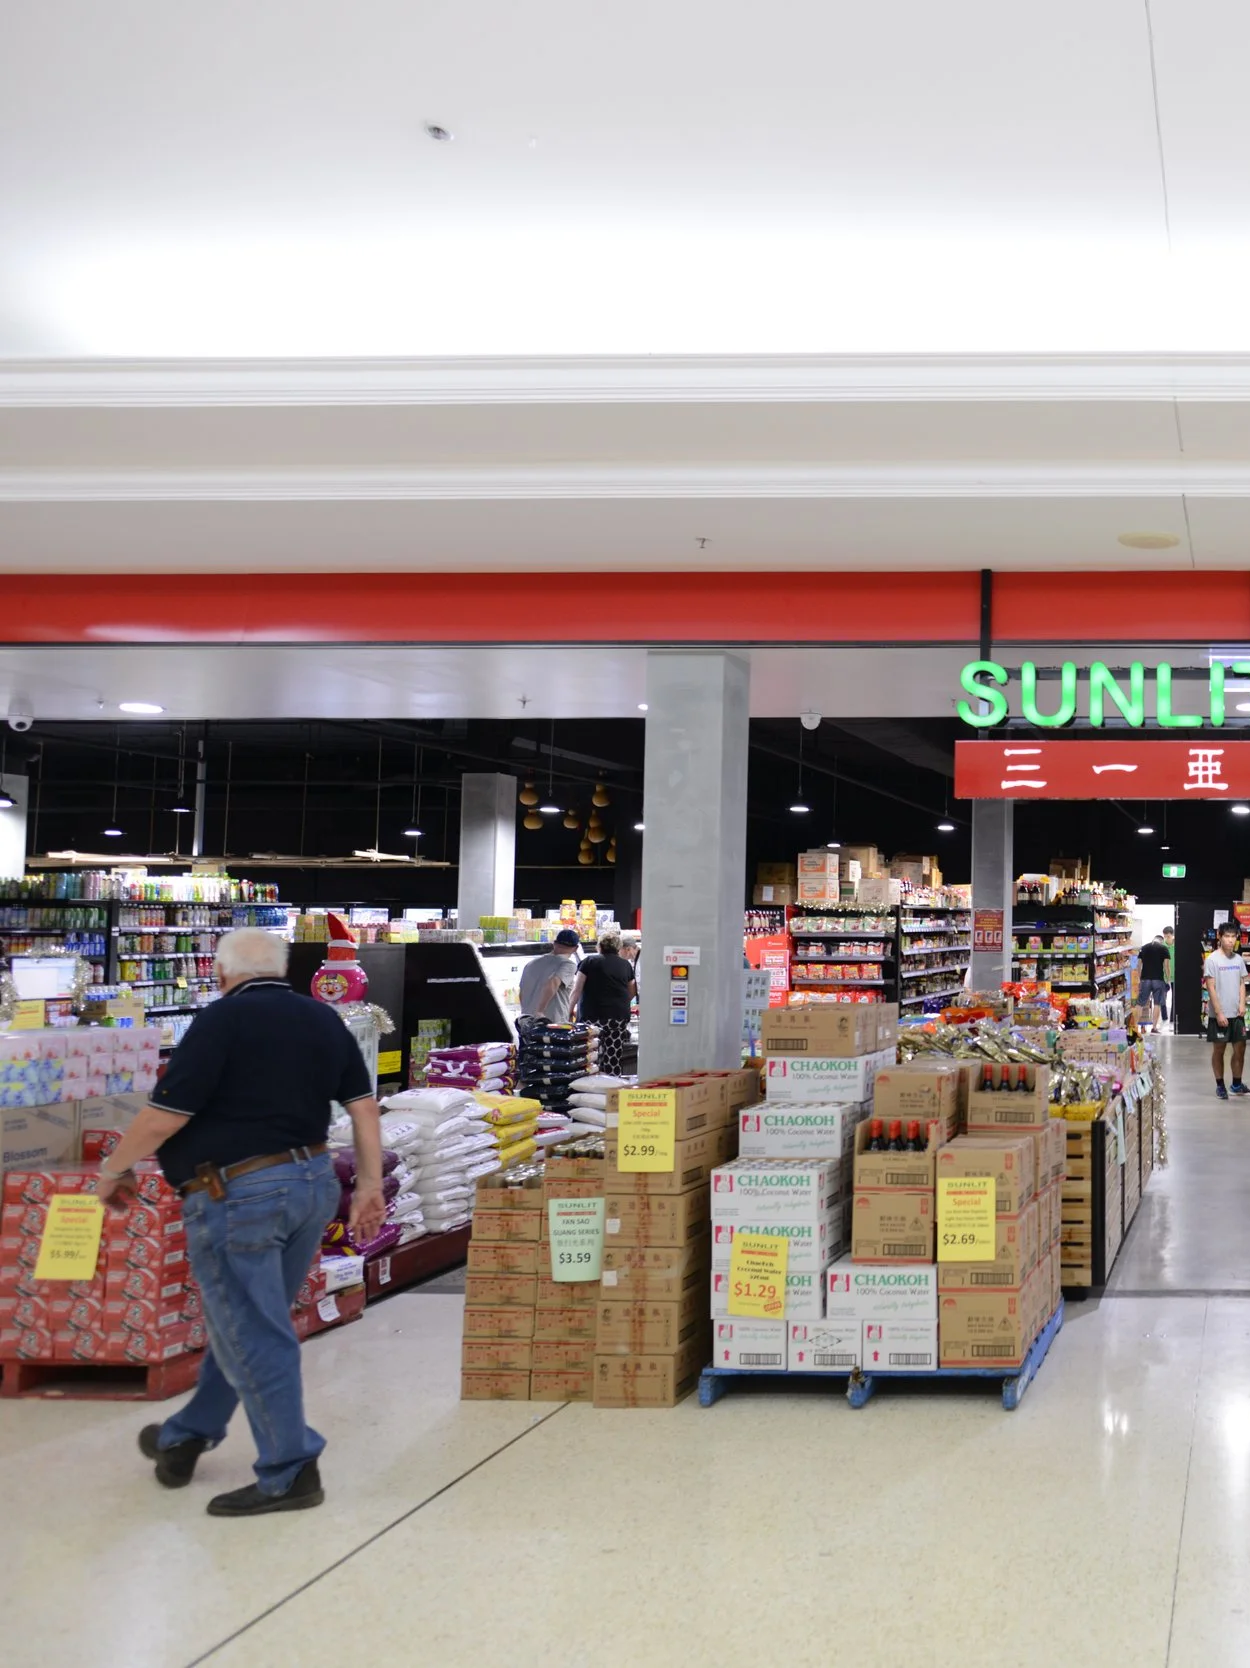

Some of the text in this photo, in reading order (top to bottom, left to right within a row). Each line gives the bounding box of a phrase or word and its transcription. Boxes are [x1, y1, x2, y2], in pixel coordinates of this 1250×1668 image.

[790, 1061, 857, 1071] CHAOKOH
[632, 1109, 660, 1118] Special
[764, 1115, 834, 1126] CHAOKOH
[3, 1147, 48, 1163] Blossom
[737, 1174, 811, 1186] CHAOKOH
[761, 1188, 790, 1196] Coconut
[792, 1188, 811, 1196] Water
[952, 1198, 981, 1207] Special
[559, 1252, 591, 1264] $3.59
[854, 1274, 929, 1286] CHAOKOH
[734, 1281, 777, 1299] $1.29
[879, 1288, 907, 1296] Coconut
[909, 1288, 929, 1296] Water
